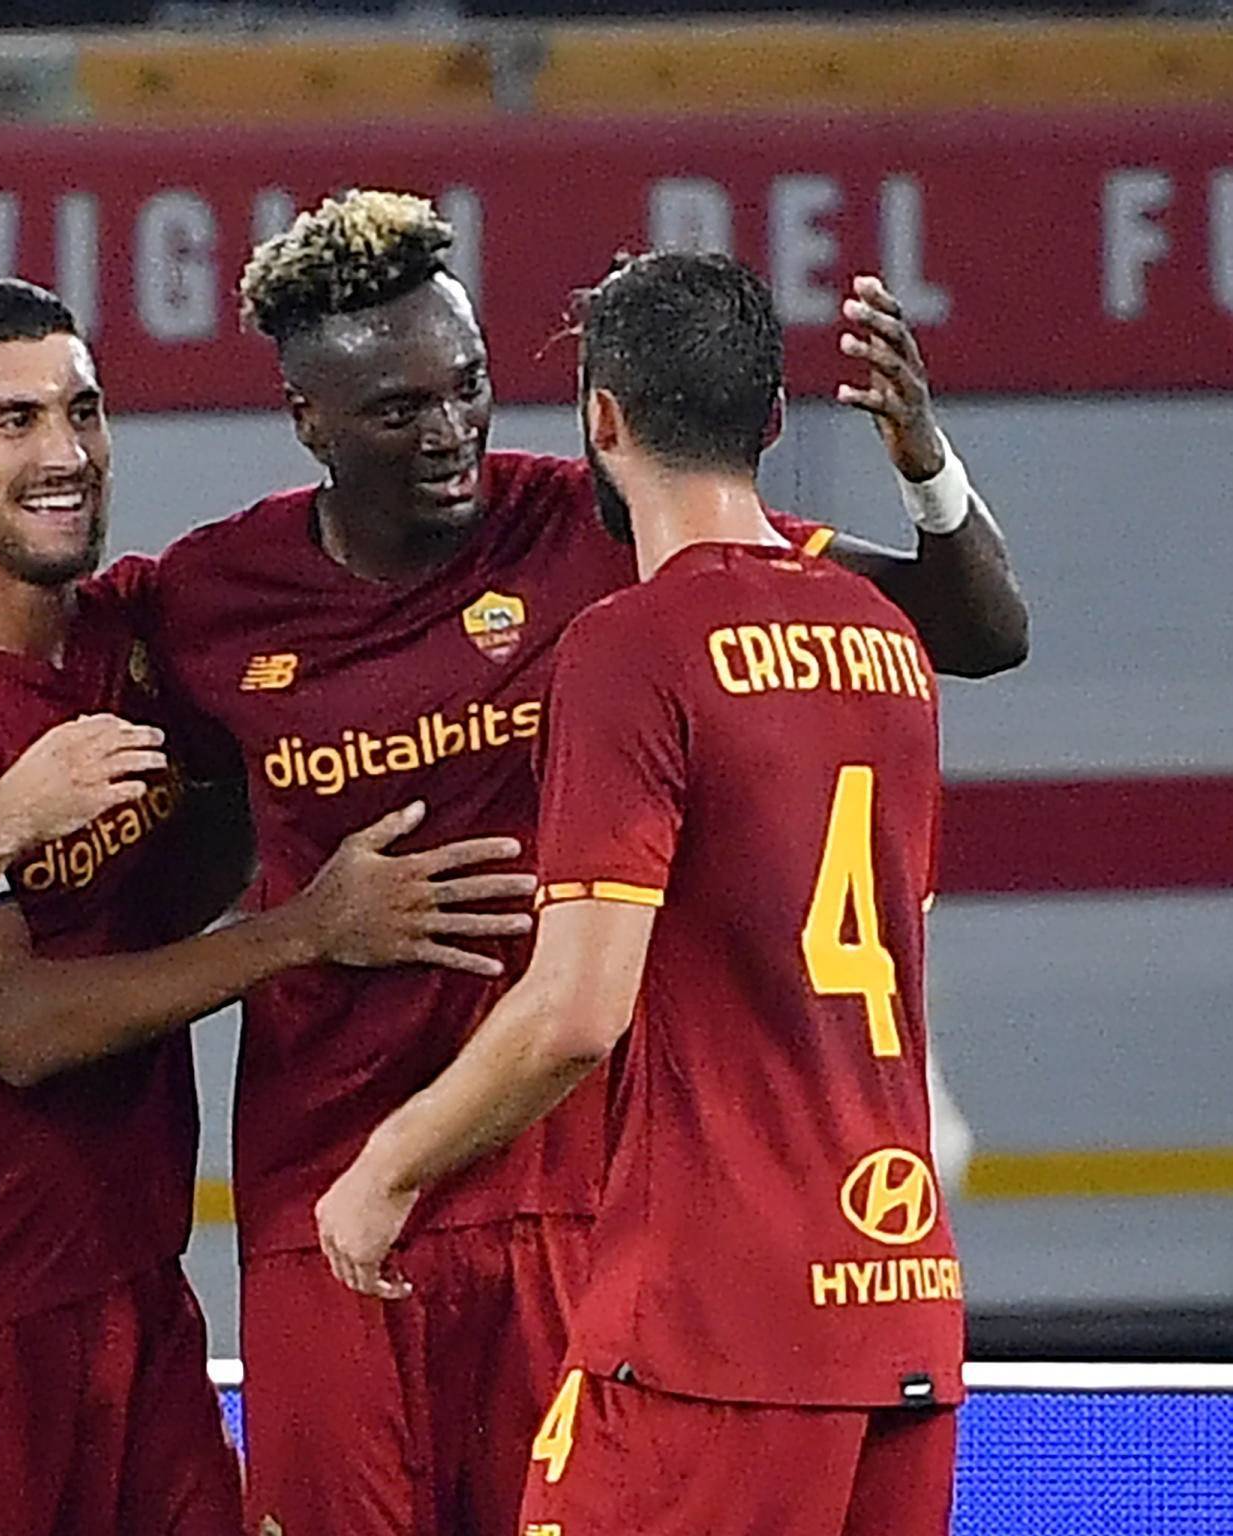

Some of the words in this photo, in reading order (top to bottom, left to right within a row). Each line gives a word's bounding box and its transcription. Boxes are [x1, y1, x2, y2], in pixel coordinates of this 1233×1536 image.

[265, 701, 541, 795] digitalbits
[803, 766, 900, 1057] 4
[532, 1369, 583, 1483] 4
